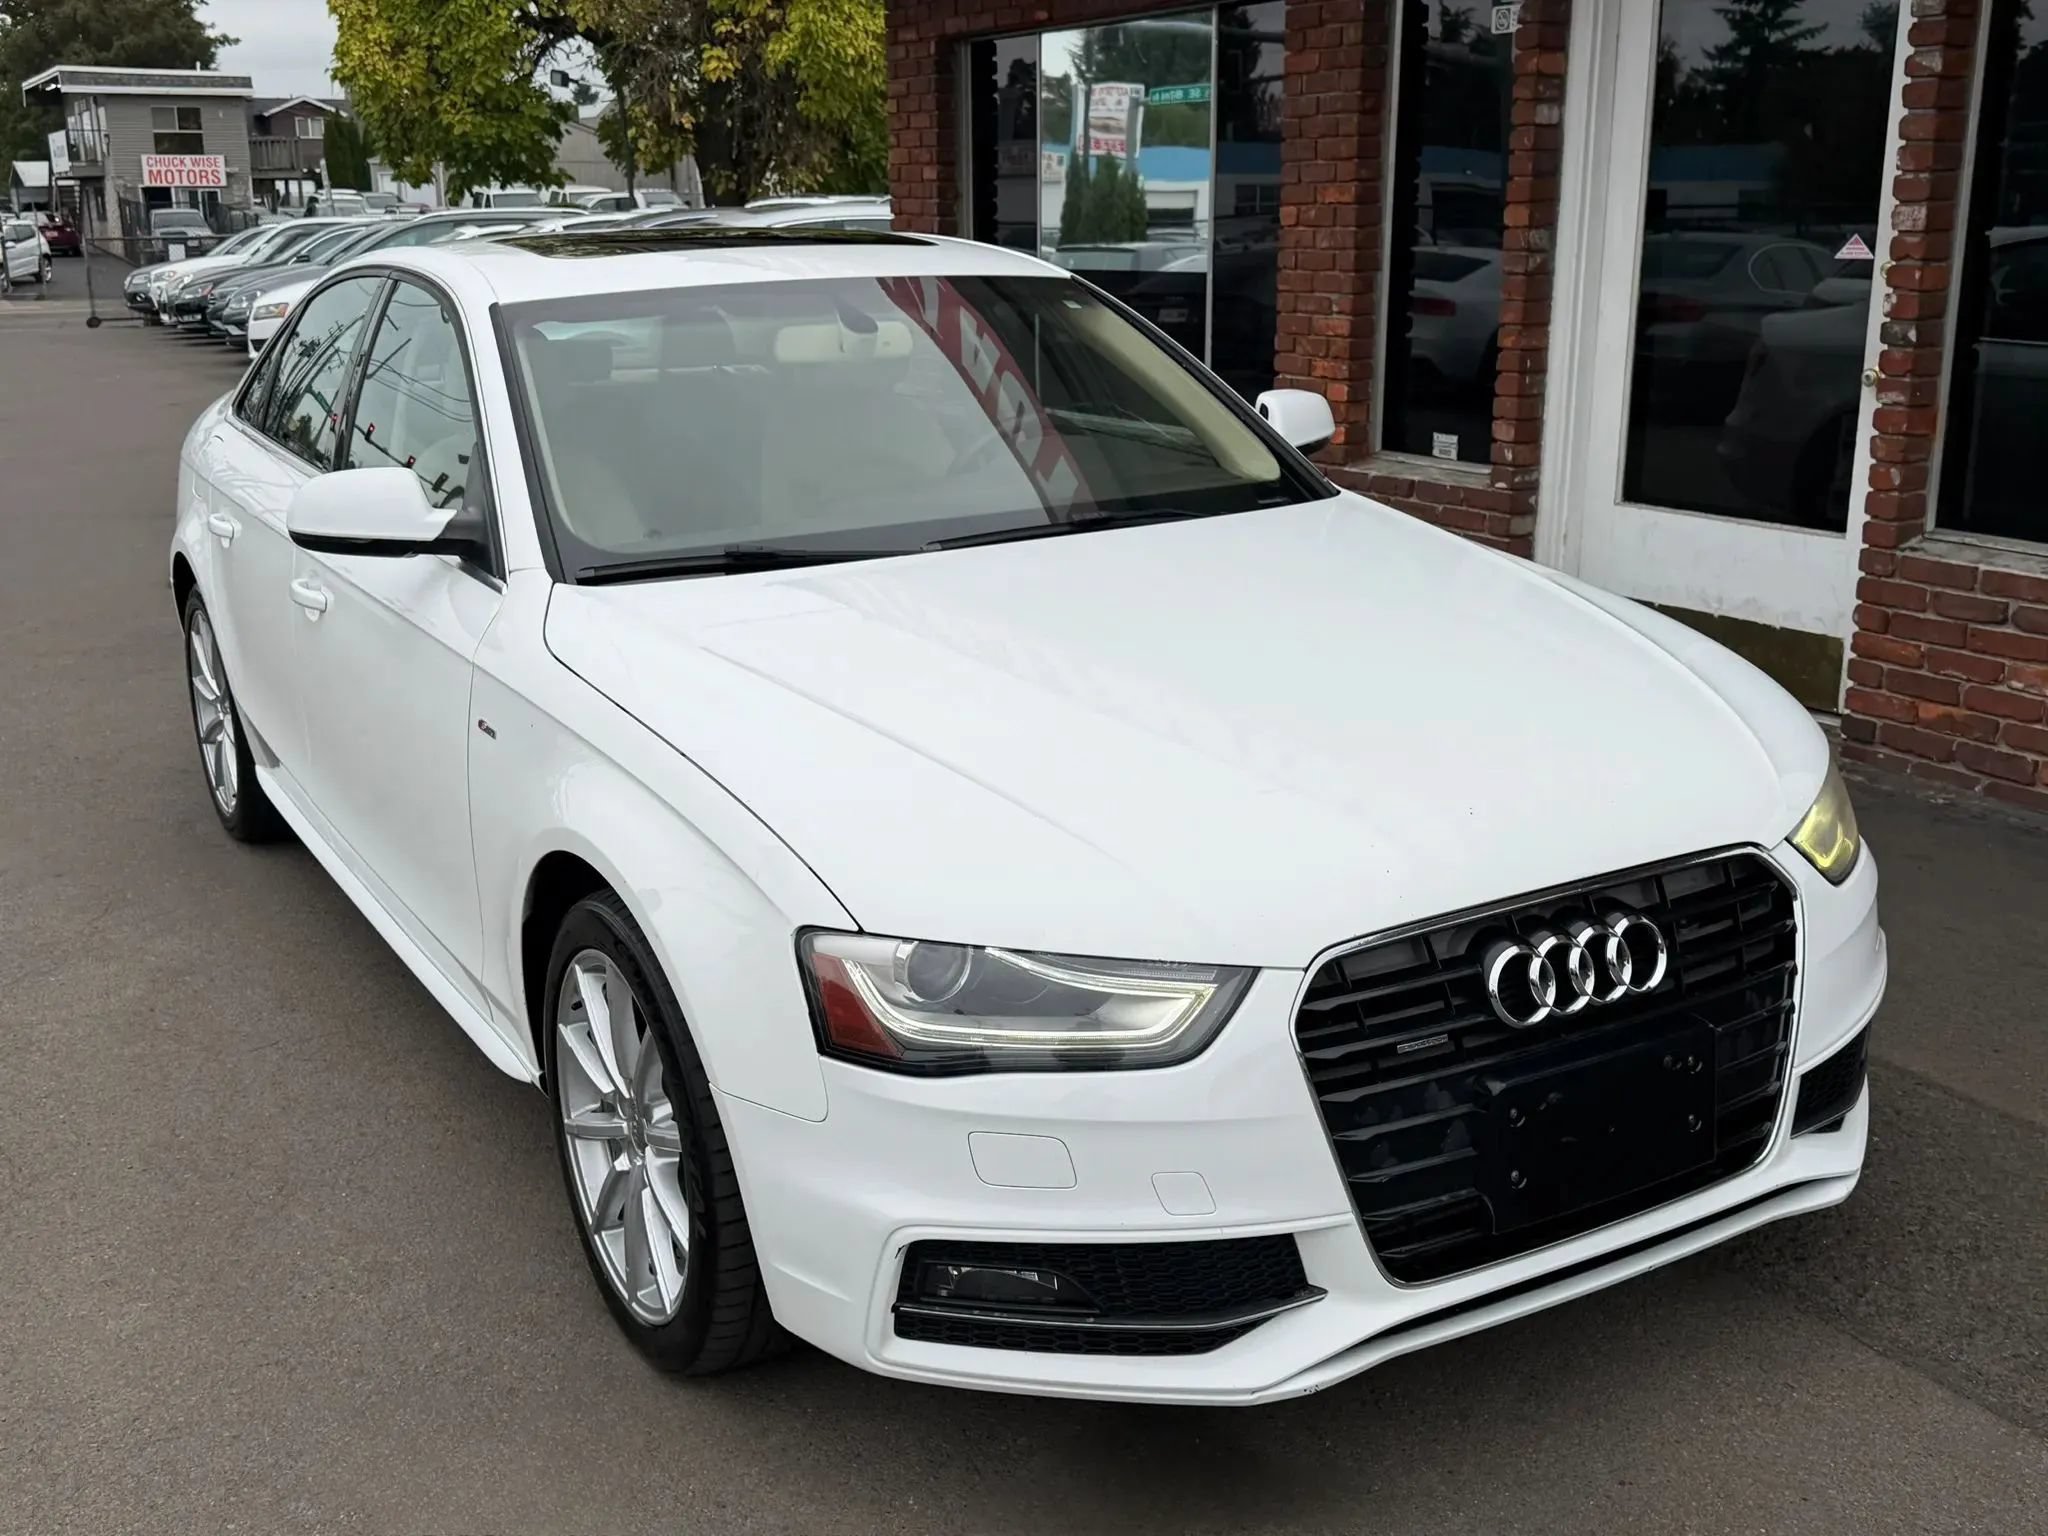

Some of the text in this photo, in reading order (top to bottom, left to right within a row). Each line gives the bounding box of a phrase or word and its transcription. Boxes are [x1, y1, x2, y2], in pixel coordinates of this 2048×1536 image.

[146, 156, 221, 169] CHUCK WISE
[148, 169, 222, 185] MOTORS
